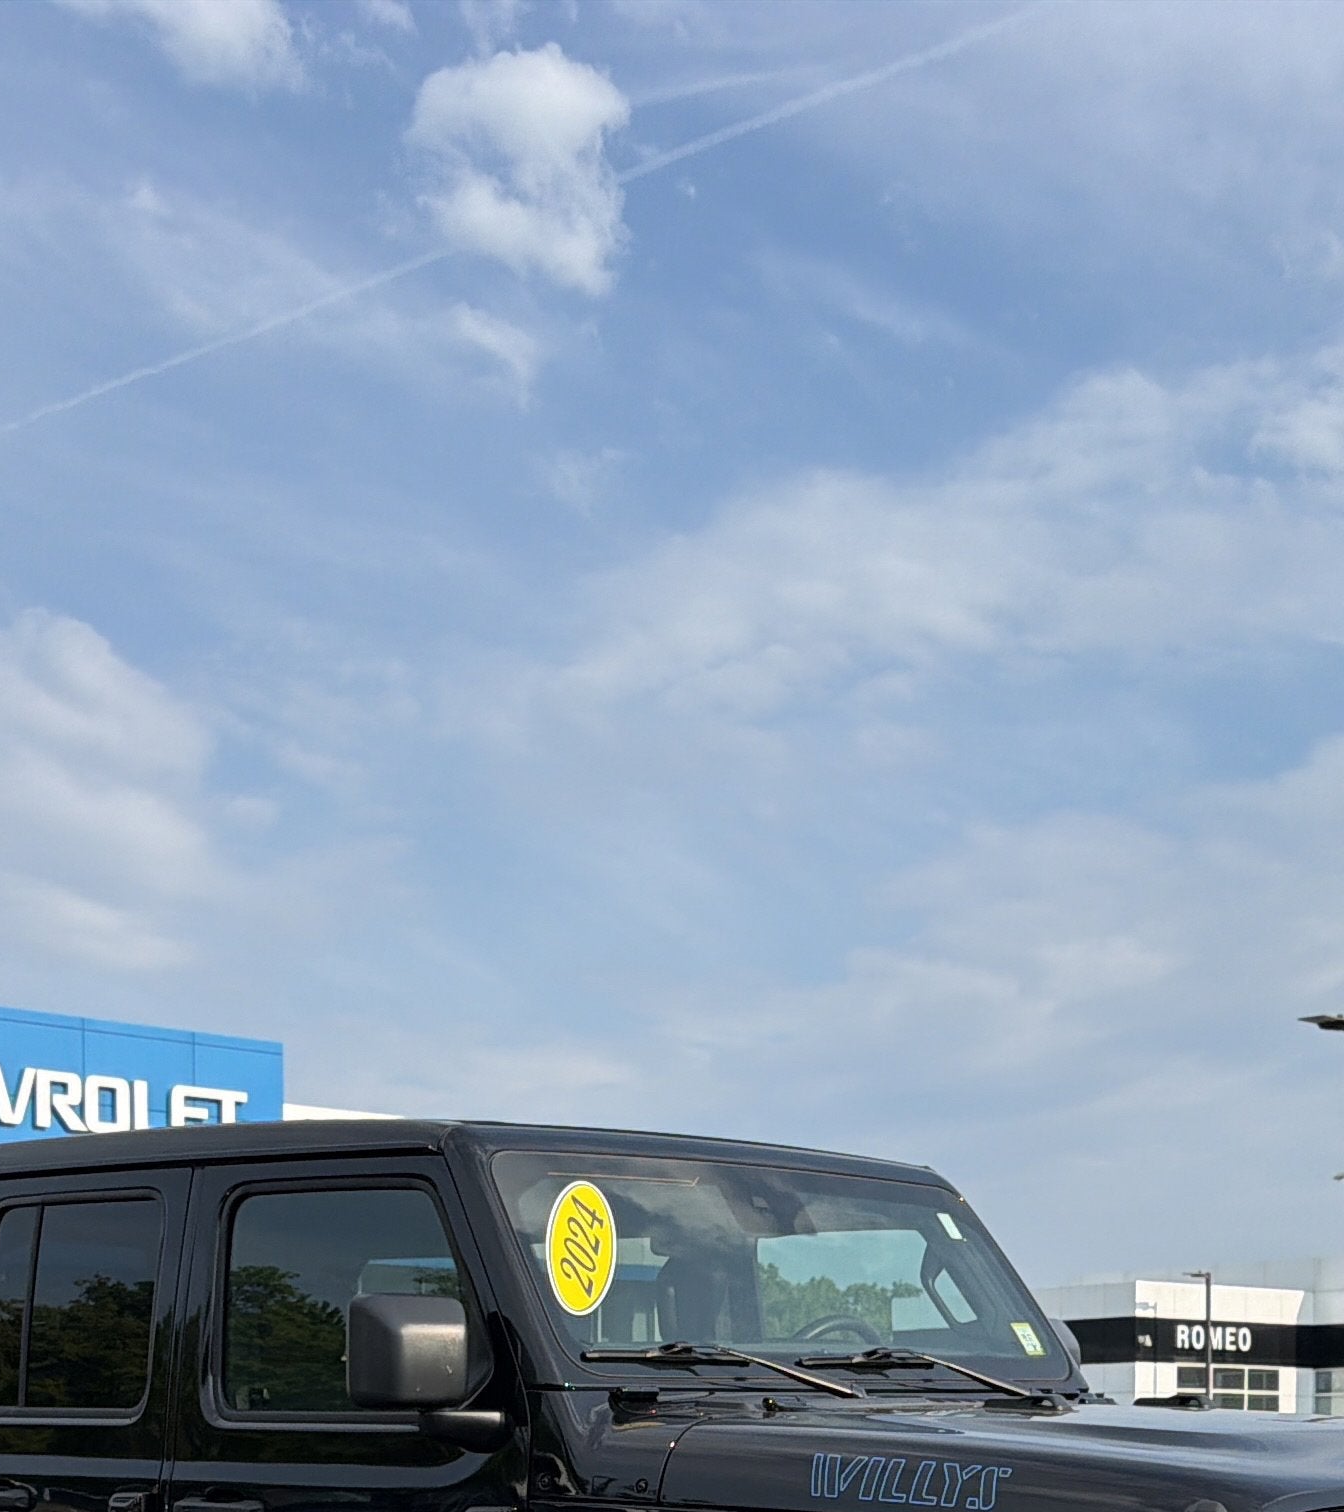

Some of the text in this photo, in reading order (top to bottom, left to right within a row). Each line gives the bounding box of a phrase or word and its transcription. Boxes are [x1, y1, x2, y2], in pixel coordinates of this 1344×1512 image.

[559, 1194, 605, 1299] 2024
[1175, 1324, 1253, 1352] ROMEO
[810, 1452, 1013, 1511] WILLYS
